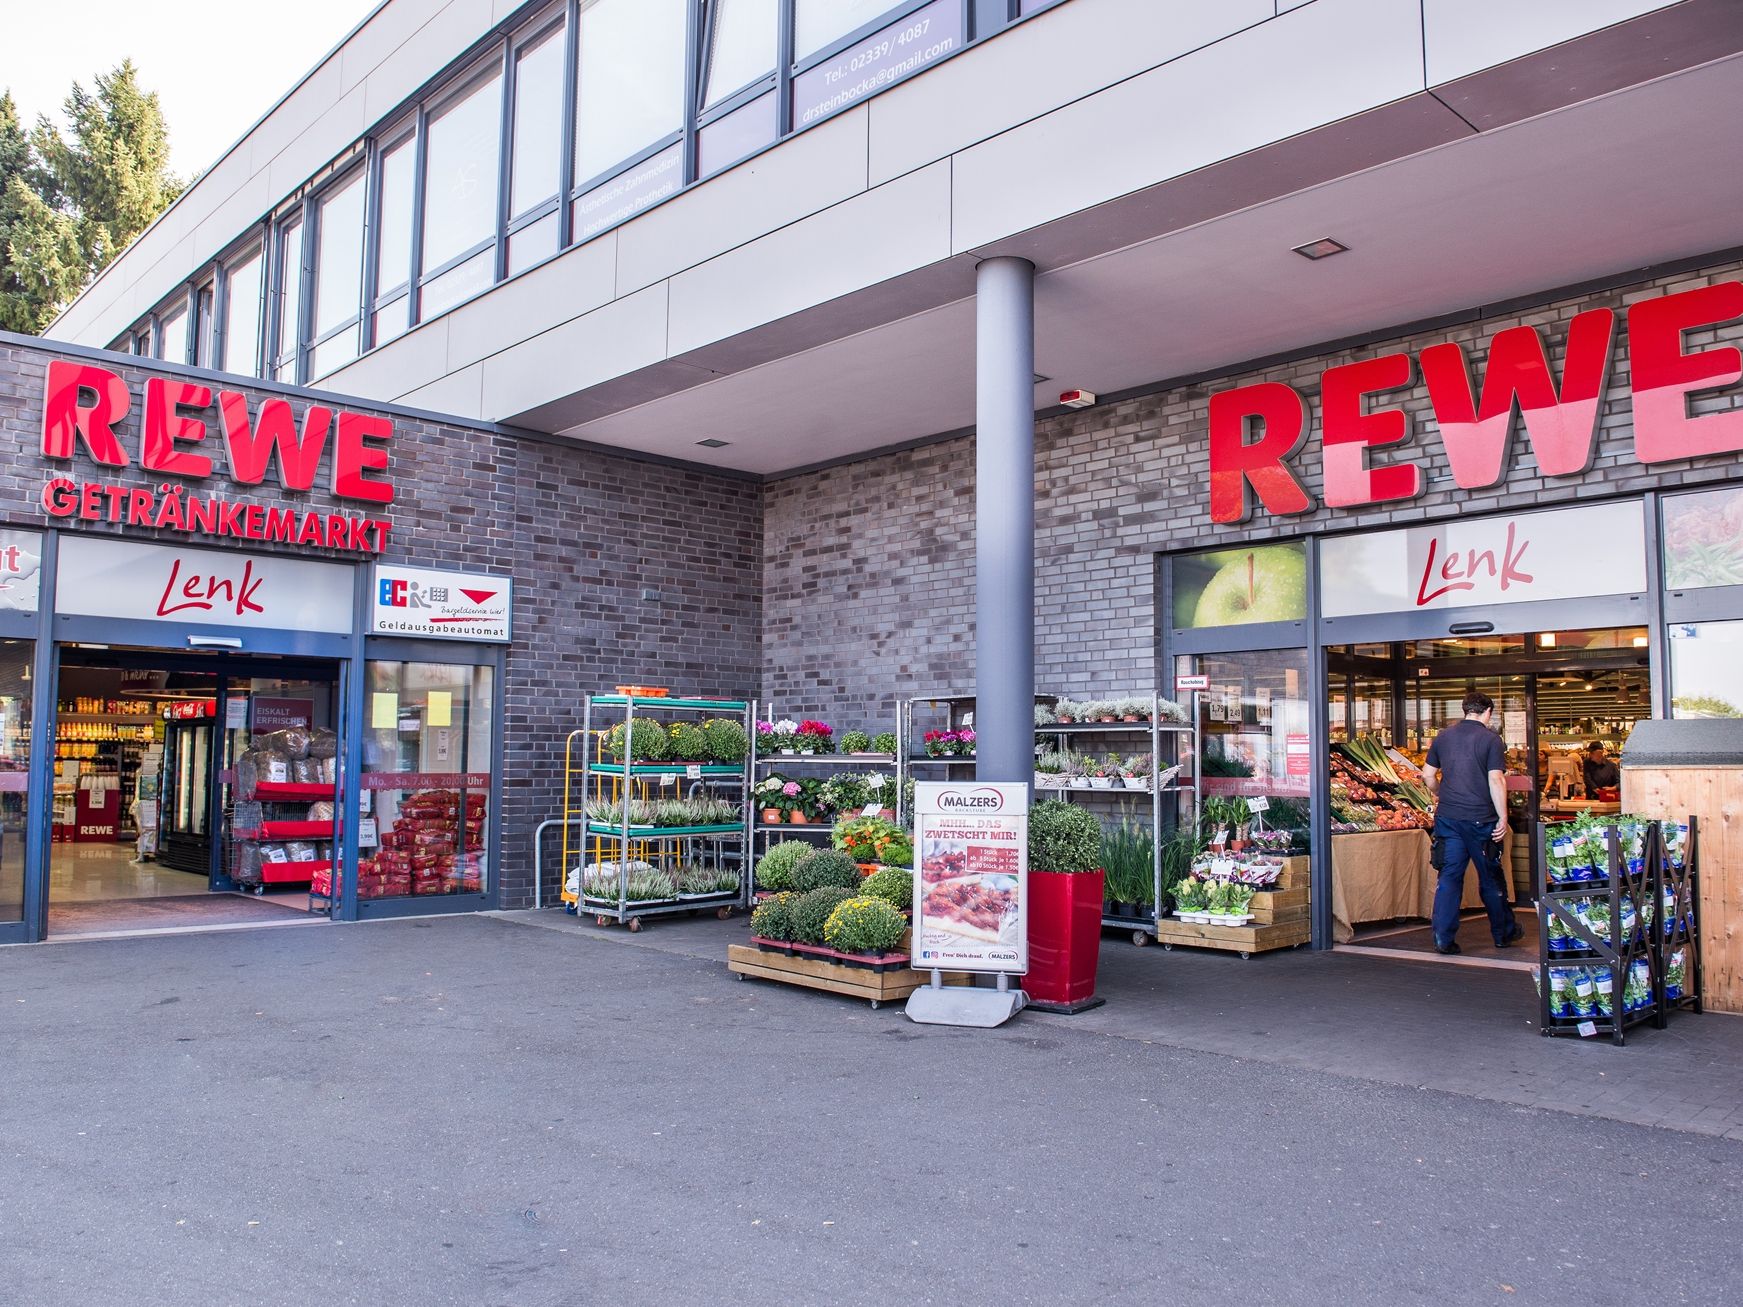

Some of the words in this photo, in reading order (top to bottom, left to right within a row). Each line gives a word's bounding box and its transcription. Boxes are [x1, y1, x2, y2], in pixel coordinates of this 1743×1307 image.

[802, 37, 954, 123] drsteinbocka@gmail.com
[824, 65, 848, 85] Tel.:
[625, 154, 680, 192] Zahnmedizin
[1209, 281, 1743, 526] REWE
[41, 360, 395, 504] REWE
[42, 478, 393, 554] GETRÄNKEMARKT
[1416, 521, 1534, 607] Lenk
[156, 558, 265, 616] Lenk
[379, 620, 504, 636] Geldausgabeautomat
[257, 707, 290, 716] EISKALT
[368, 776, 387, 786] Mo.
[395, 776, 410, 786] Sa.
[413, 776, 433, 786] 7.00
[467, 776, 484, 785] Uhr
[943, 796, 998, 808] MALZERS
[80, 825, 114, 835] REWE
[977, 819, 1002, 829] DAS
[925, 830, 988, 840] ZWETSCHT
[990, 831, 1017, 840] MIR!
